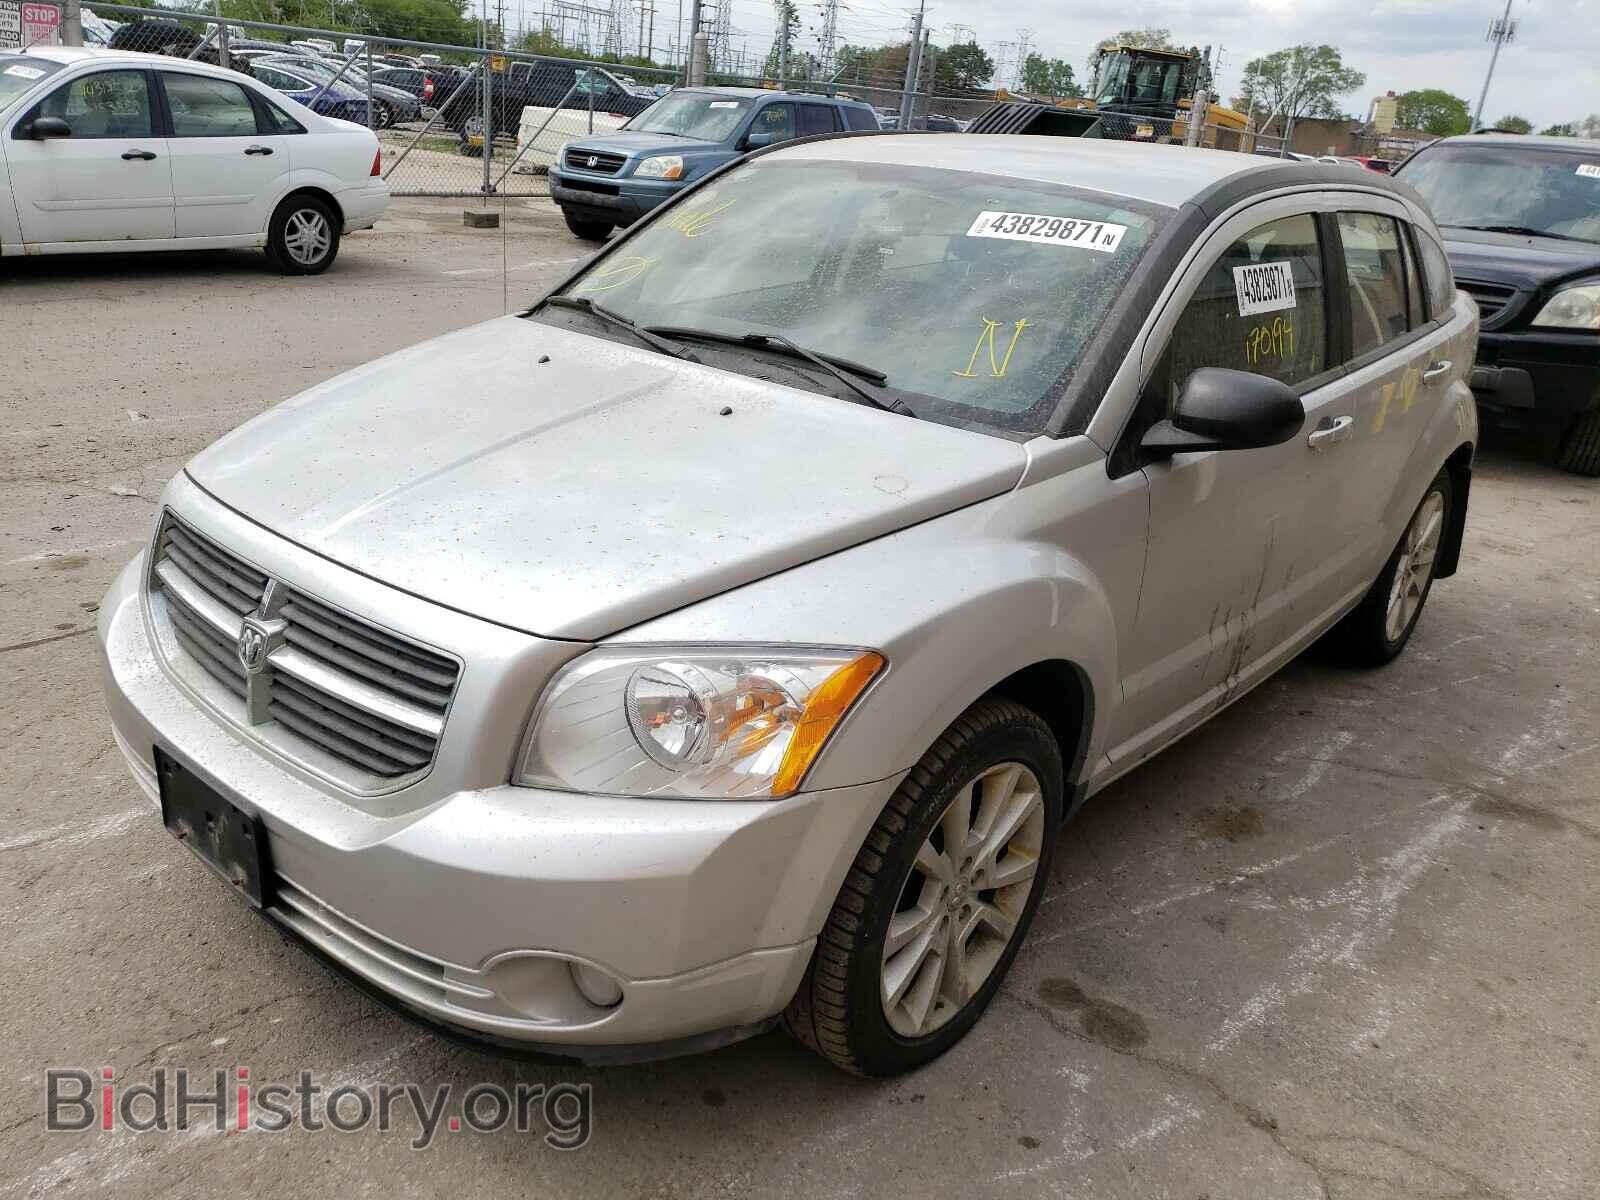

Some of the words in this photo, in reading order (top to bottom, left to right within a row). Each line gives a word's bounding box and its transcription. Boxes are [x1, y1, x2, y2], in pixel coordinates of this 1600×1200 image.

[25, 7, 56, 22] STOP
[991, 214, 1104, 244] 43829871
[1102, 233, 1116, 247] N
[1242, 265, 1288, 305] 43829871
[951, 315, 1035, 377] N
